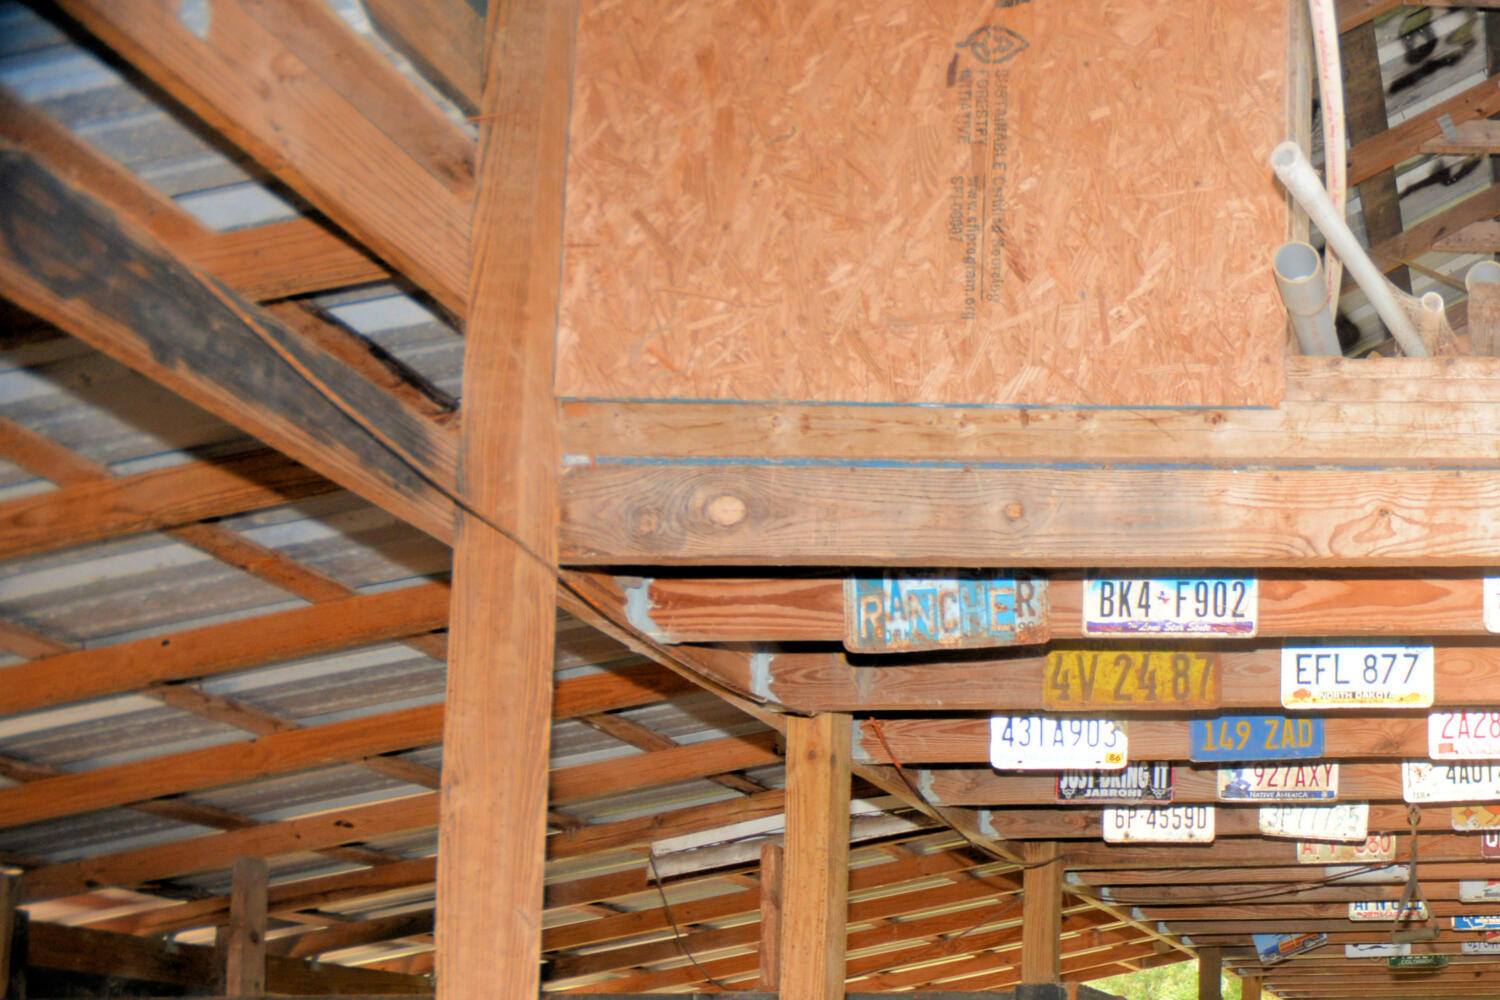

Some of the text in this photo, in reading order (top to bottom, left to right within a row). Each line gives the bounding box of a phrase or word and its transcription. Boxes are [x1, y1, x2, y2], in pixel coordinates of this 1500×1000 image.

[975, 69, 989, 146] FORESTRY
[993, 68, 1009, 172] SUSTAINABLE
[860, 577, 1037, 639] RANCHER
[1099, 581, 1246, 618] BK4 F902
[1295, 653, 1420, 685] EFL 877
[1320, 690, 1395, 699] NORTH DAKOTA
[1202, 718, 1314, 751] 149 ZAD
[1153, 763, 1169, 788] IT
[1253, 763, 1334, 788] 927AXY
[1083, 788, 1142, 798] JABRONI
[1249, 791, 1308, 799] NATIVE AMERICA
